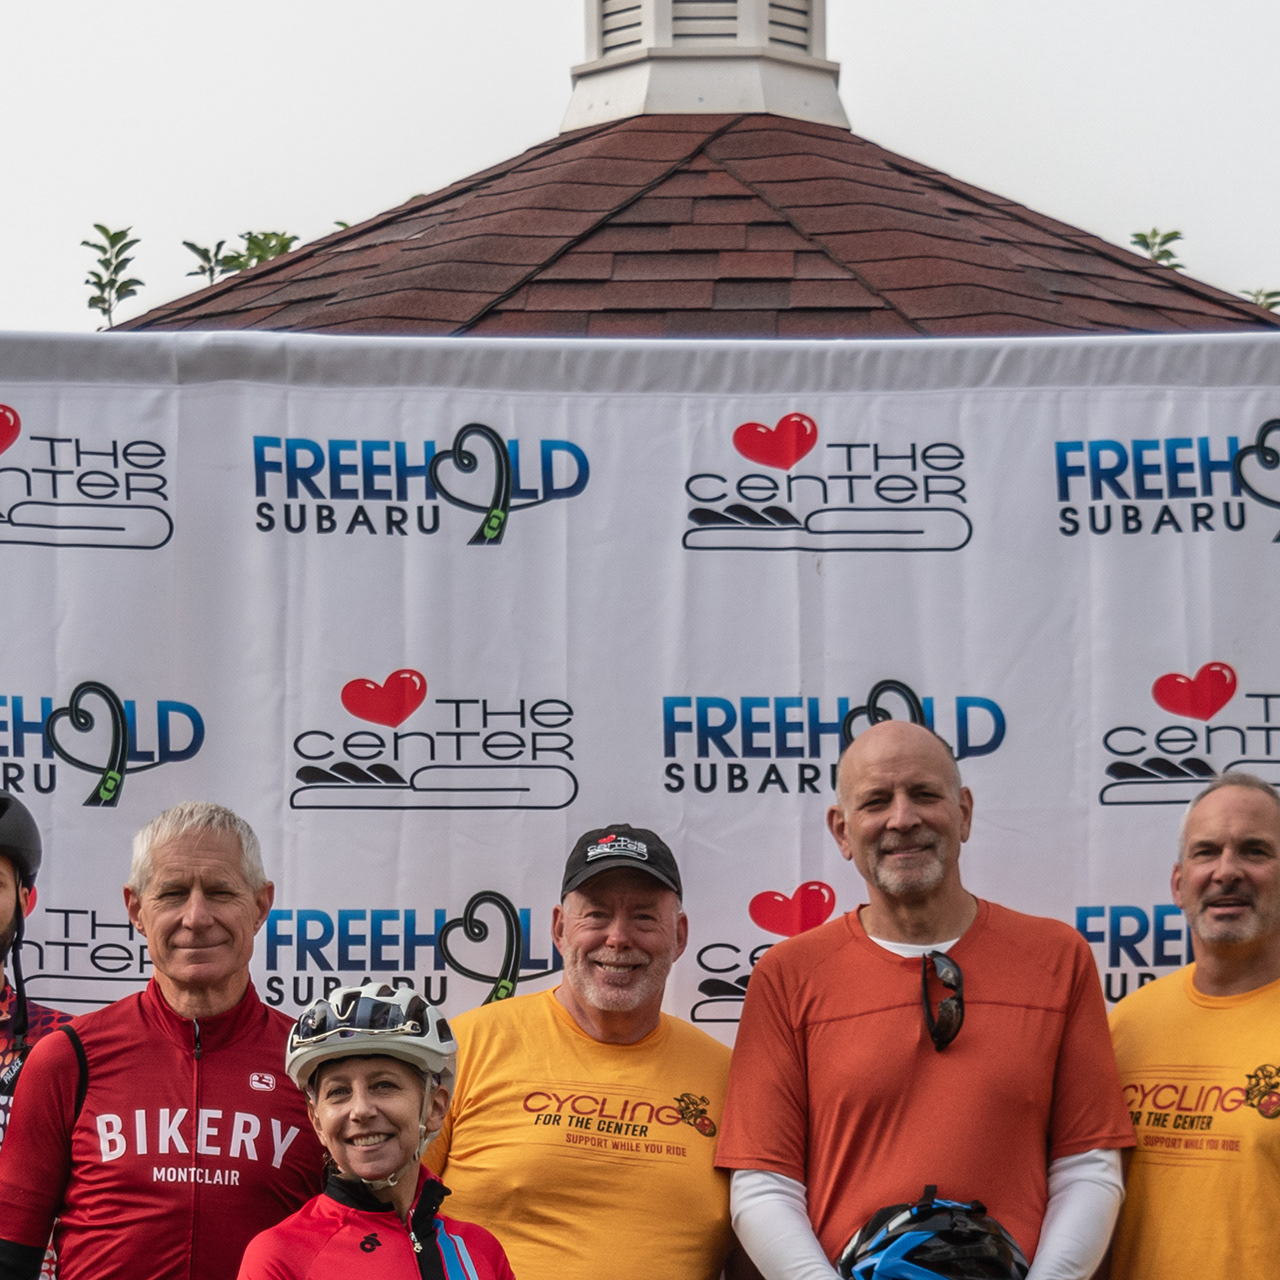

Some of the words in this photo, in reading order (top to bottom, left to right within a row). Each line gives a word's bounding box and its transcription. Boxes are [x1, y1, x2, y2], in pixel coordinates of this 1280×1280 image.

[256, 503, 440, 536] SUBARU
[1059, 502, 1247, 537] SUBARU
[664, 763, 839, 794] SUBAR
[45, 908, 135, 941] TH
[265, 893, 563, 982] FREEHOL
[534, 1114, 562, 1126] FOR
[568, 1115, 593, 1130] THE
[597, 1119, 649, 1137] CENTER
[1146, 1112, 1170, 1128] THE
[1172, 1114, 1213, 1130] CENTER
[96, 1107, 300, 1169] BIKERY
[566, 1133, 608, 1149] SUPPORT
[611, 1140, 641, 1152] WHILE
[645, 1143, 663, 1154] YOU
[666, 1146, 687, 1157] RIDE
[1143, 1135, 1182, 1149] SUPPORT
[153, 1166, 240, 1187] MONTCLAIR
